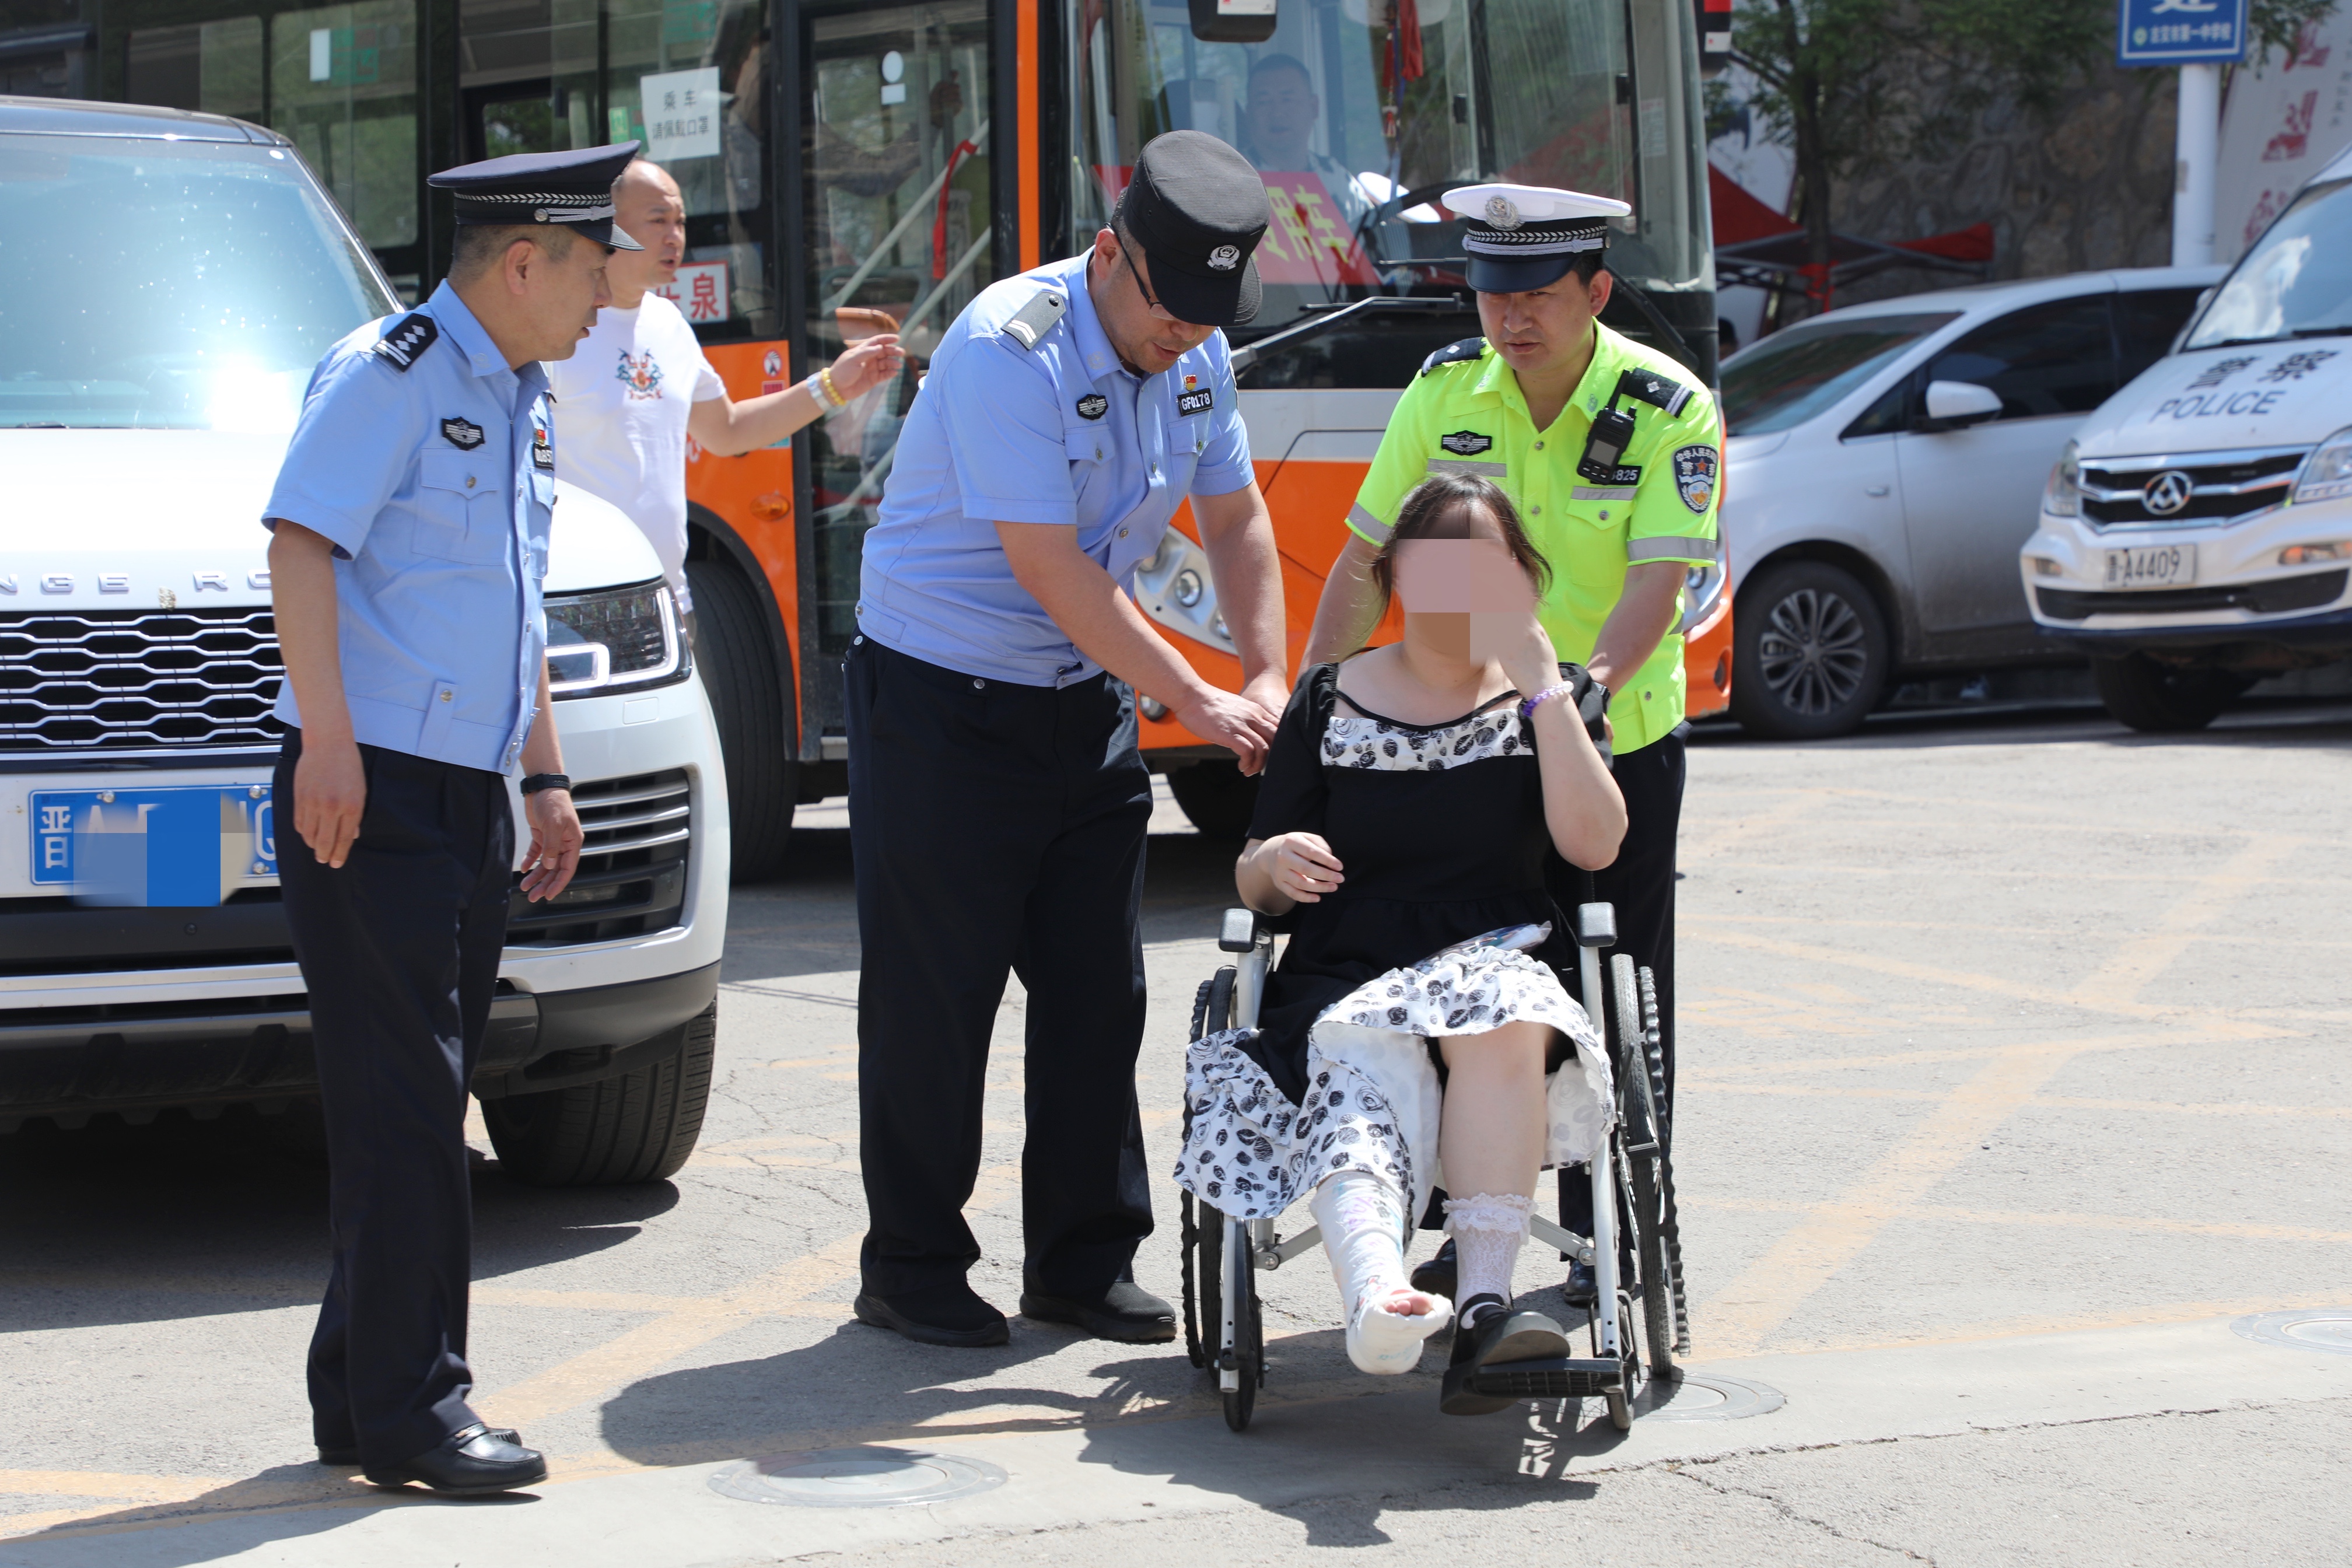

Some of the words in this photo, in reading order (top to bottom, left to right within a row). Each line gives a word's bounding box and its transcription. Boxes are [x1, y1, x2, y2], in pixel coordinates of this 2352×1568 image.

[663, 89, 697, 111] 乘车
[652, 115, 709, 140] 请佩戴口罩
[2186, 349, 2340, 391] 警察
[1181, 393, 1211, 410] GF0178
[2148, 390, 2286, 424] POLICE
